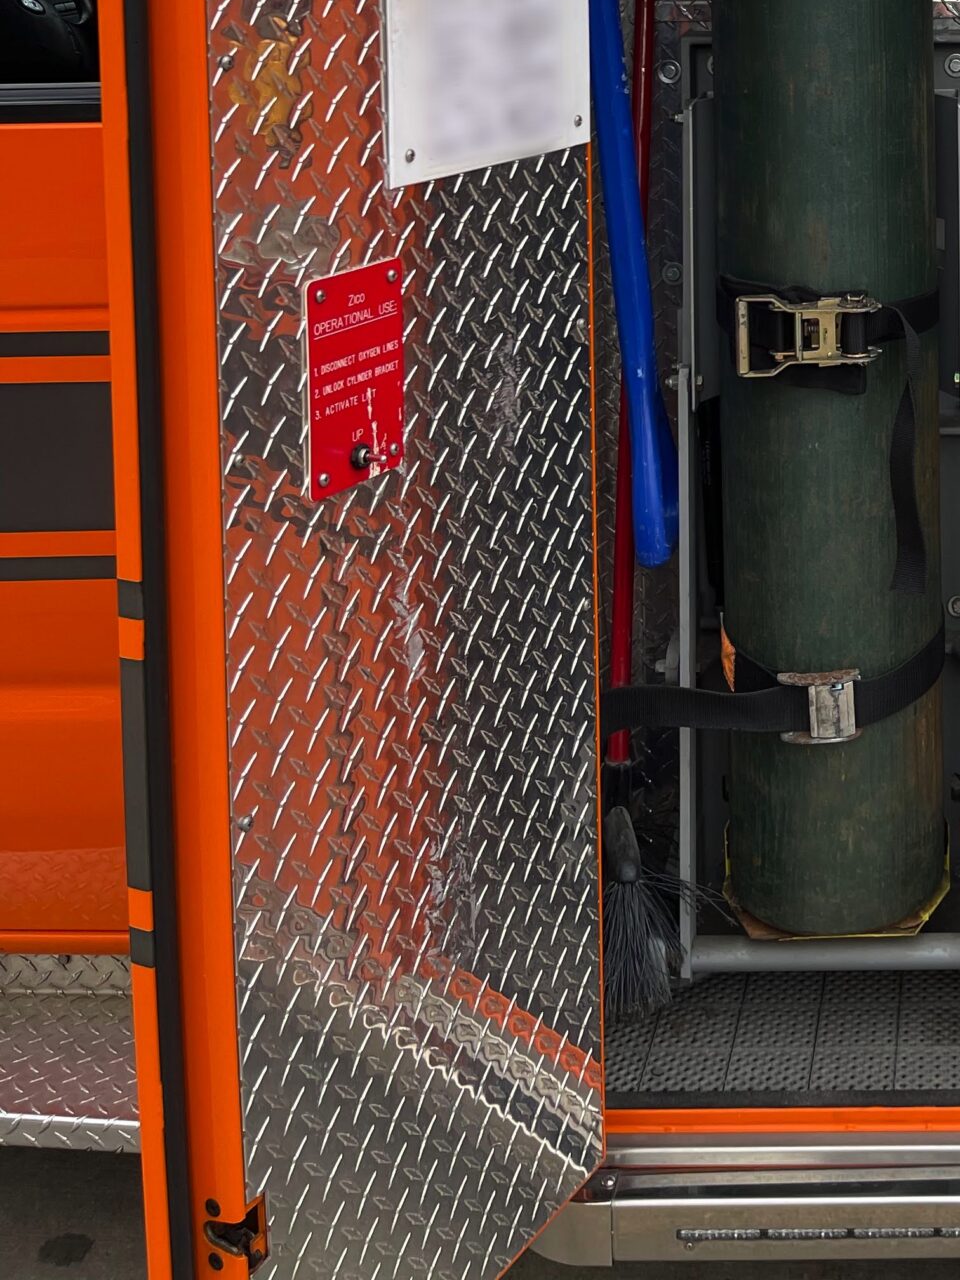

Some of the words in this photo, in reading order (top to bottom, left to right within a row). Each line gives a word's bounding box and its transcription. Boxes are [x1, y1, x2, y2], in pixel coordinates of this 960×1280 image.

[313, 308, 374, 336] OPERATIONAL
[320, 354, 355, 375] DISCONNECT
[358, 346, 380, 361] OXYGEN
[382, 340, 398, 353] LINES
[322, 379, 344, 396] UNLOCK
[347, 369, 372, 387] CYLINDER
[375, 360, 399, 377] BRACKET
[315, 410, 322, 420] 3.
[325, 395, 358, 416] ACTIVATE
[362, 388, 376, 402] LIT
[352, 428, 364, 442] UP
